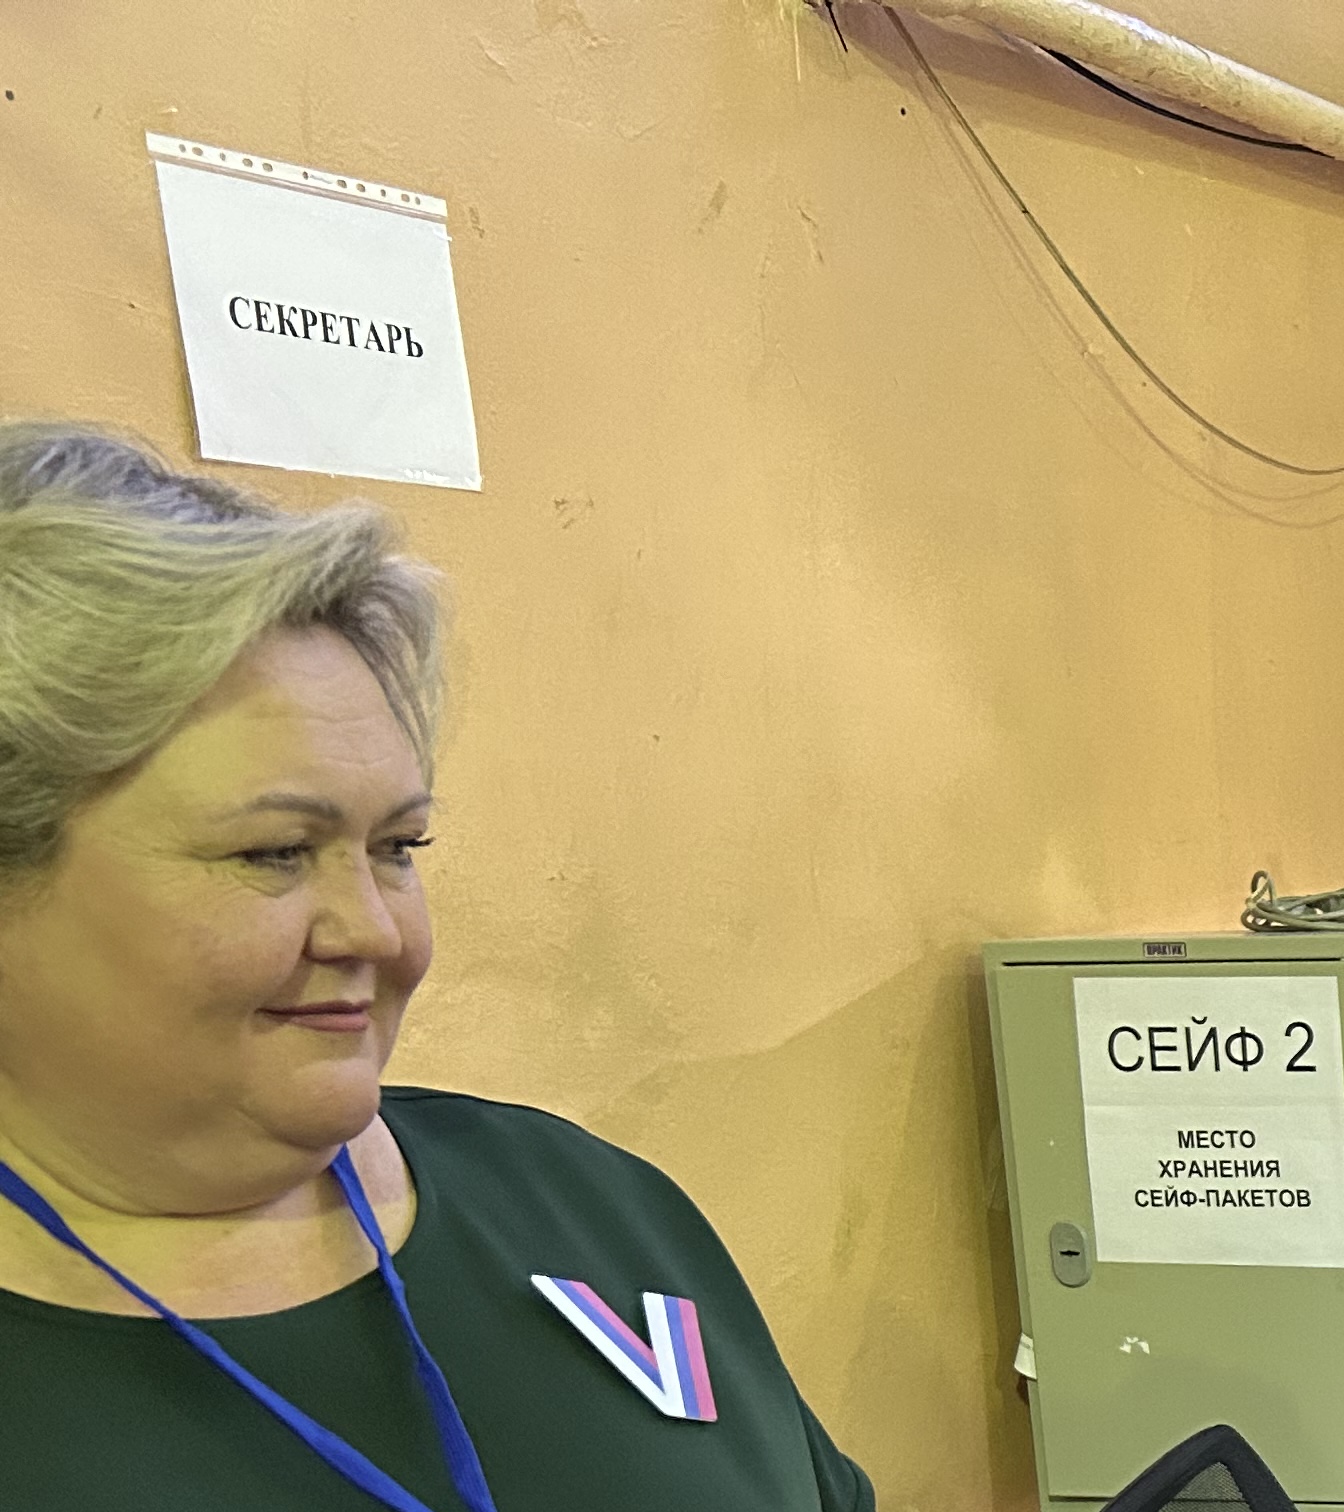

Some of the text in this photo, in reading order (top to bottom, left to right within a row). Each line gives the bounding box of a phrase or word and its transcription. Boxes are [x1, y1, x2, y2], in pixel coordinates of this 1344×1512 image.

[228, 296, 424, 358] СЕКРЕТАРЬ
[1107, 1016, 1317, 1072] СЕЙФ 2
[1177, 1130, 1256, 1149] МЕСТО
[1158, 1160, 1281, 1178] ХРАНЕНИЯ
[1134, 1185, 1312, 1208] СЕЙФ-ПАКЕТОВ
